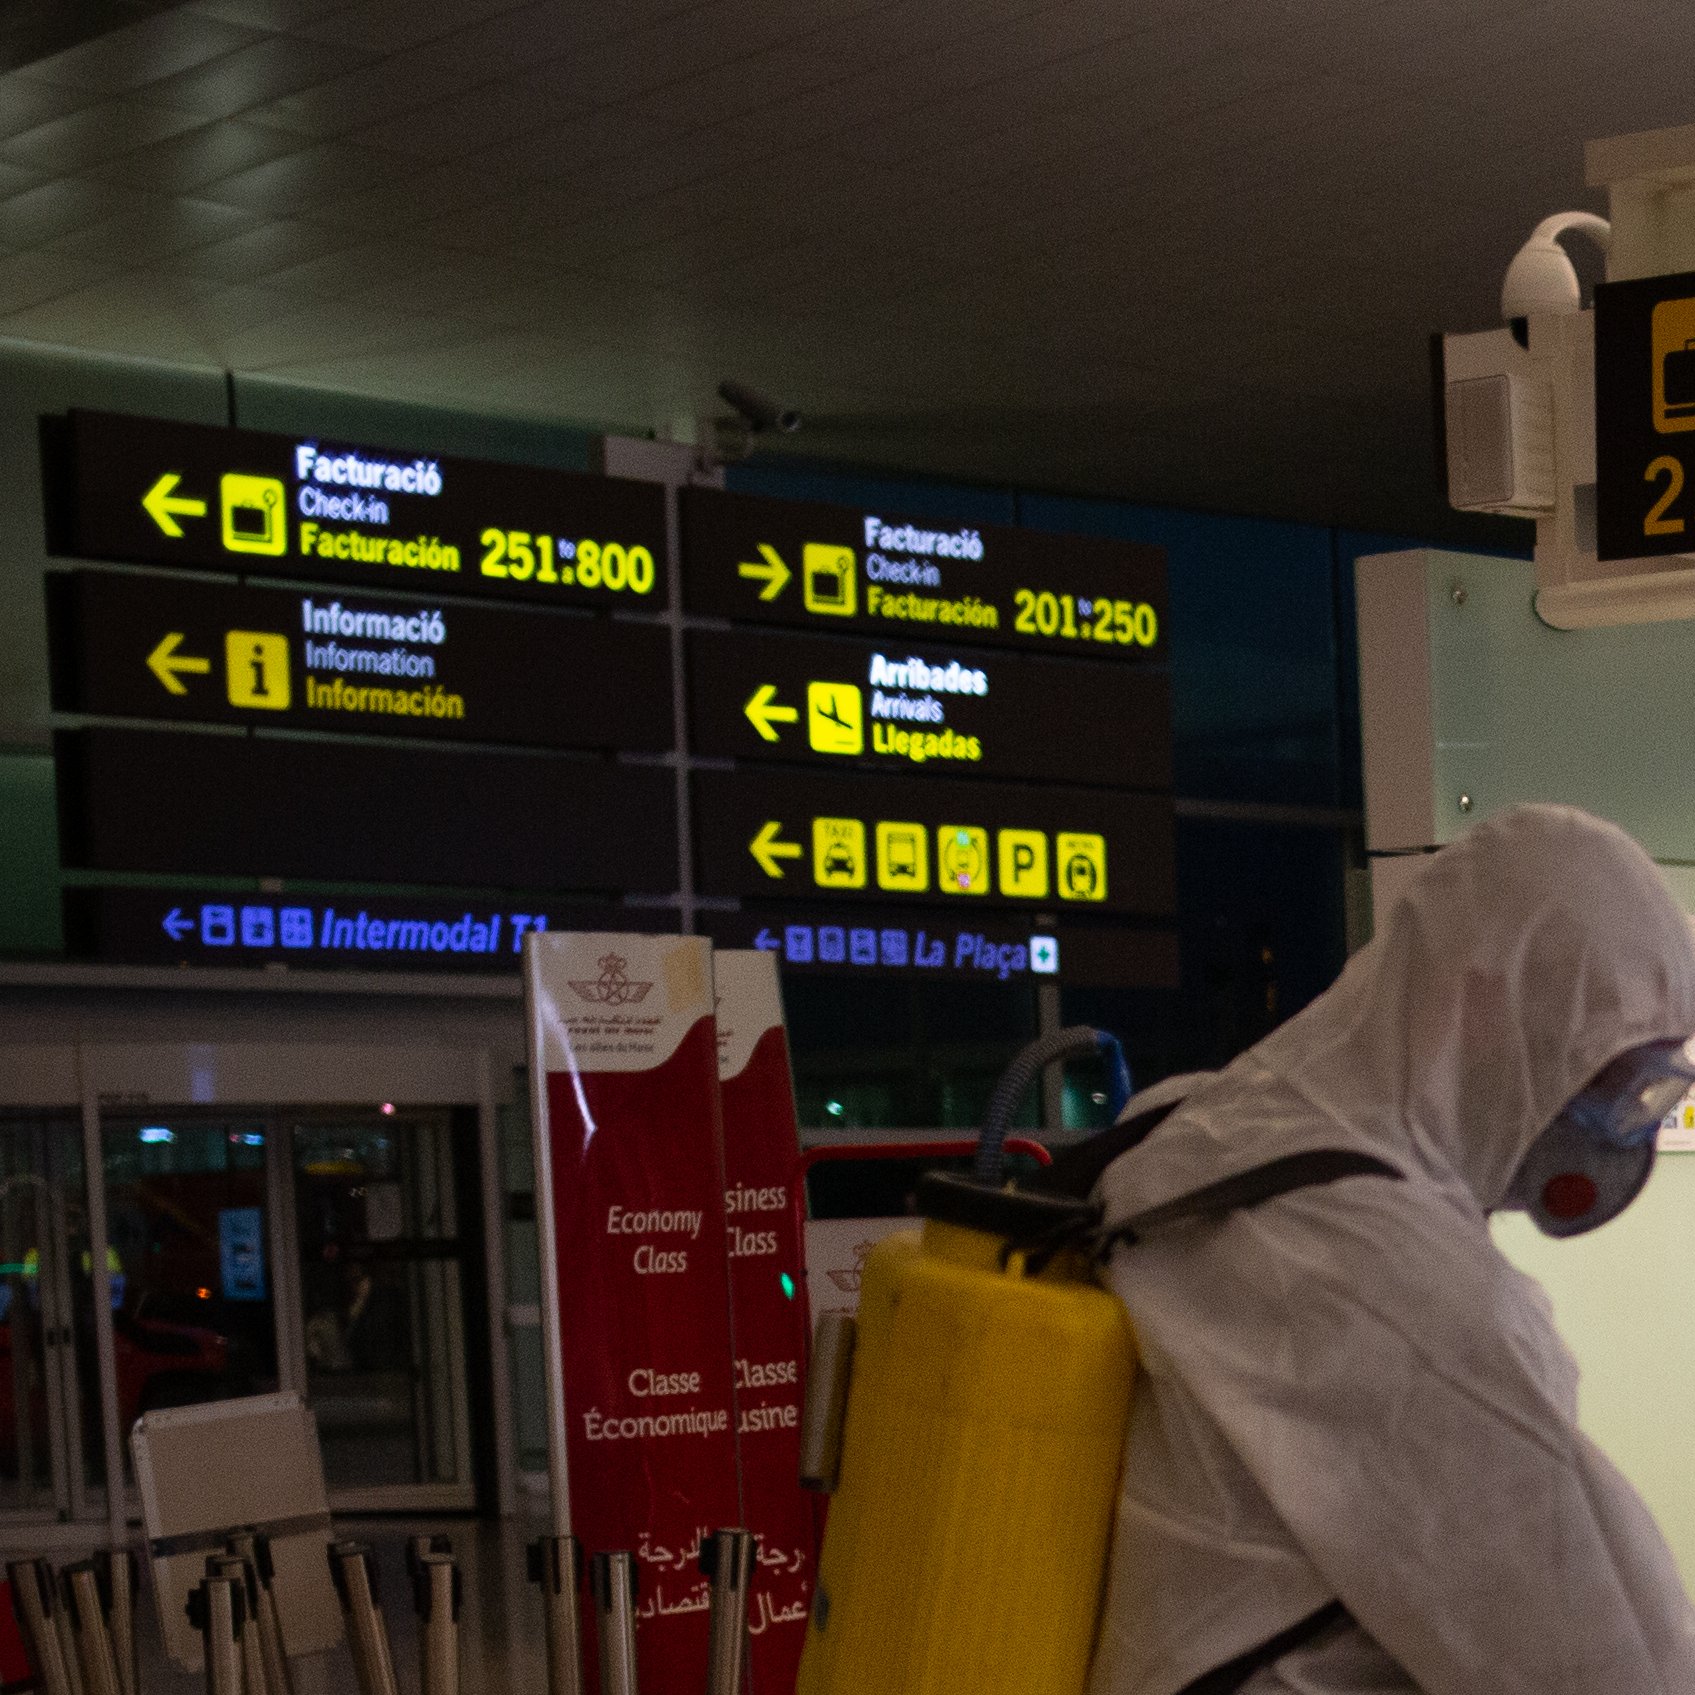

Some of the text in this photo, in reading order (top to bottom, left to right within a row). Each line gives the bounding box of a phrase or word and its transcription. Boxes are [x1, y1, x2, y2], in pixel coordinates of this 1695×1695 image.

[296, 445, 443, 496] Facturació
[300, 486, 390, 525] Check-in
[301, 521, 462, 572] Facturación
[481, 527, 557, 584] 251
[576, 538, 655, 594] 800
[864, 515, 985, 562] Facturació
[303, 599, 447, 645] Informació
[867, 585, 999, 630] Facturación
[1014, 588, 1077, 639] 201
[1092, 598, 1158, 647] 250
[305, 640, 435, 677] Information
[869, 653, 989, 696] Arribades
[307, 675, 465, 719] Información
[871, 690, 945, 723] Arrivals
[873, 723, 982, 762] Llegadas
[320, 907, 500, 953] Intermodal
[915, 930, 1027, 980] La Plaça
[607, 1205, 703, 1240] Economy
[633, 1245, 688, 1275] Class
[628, 1368, 701, 1397] Classe
[583, 1406, 728, 1441] Économique
